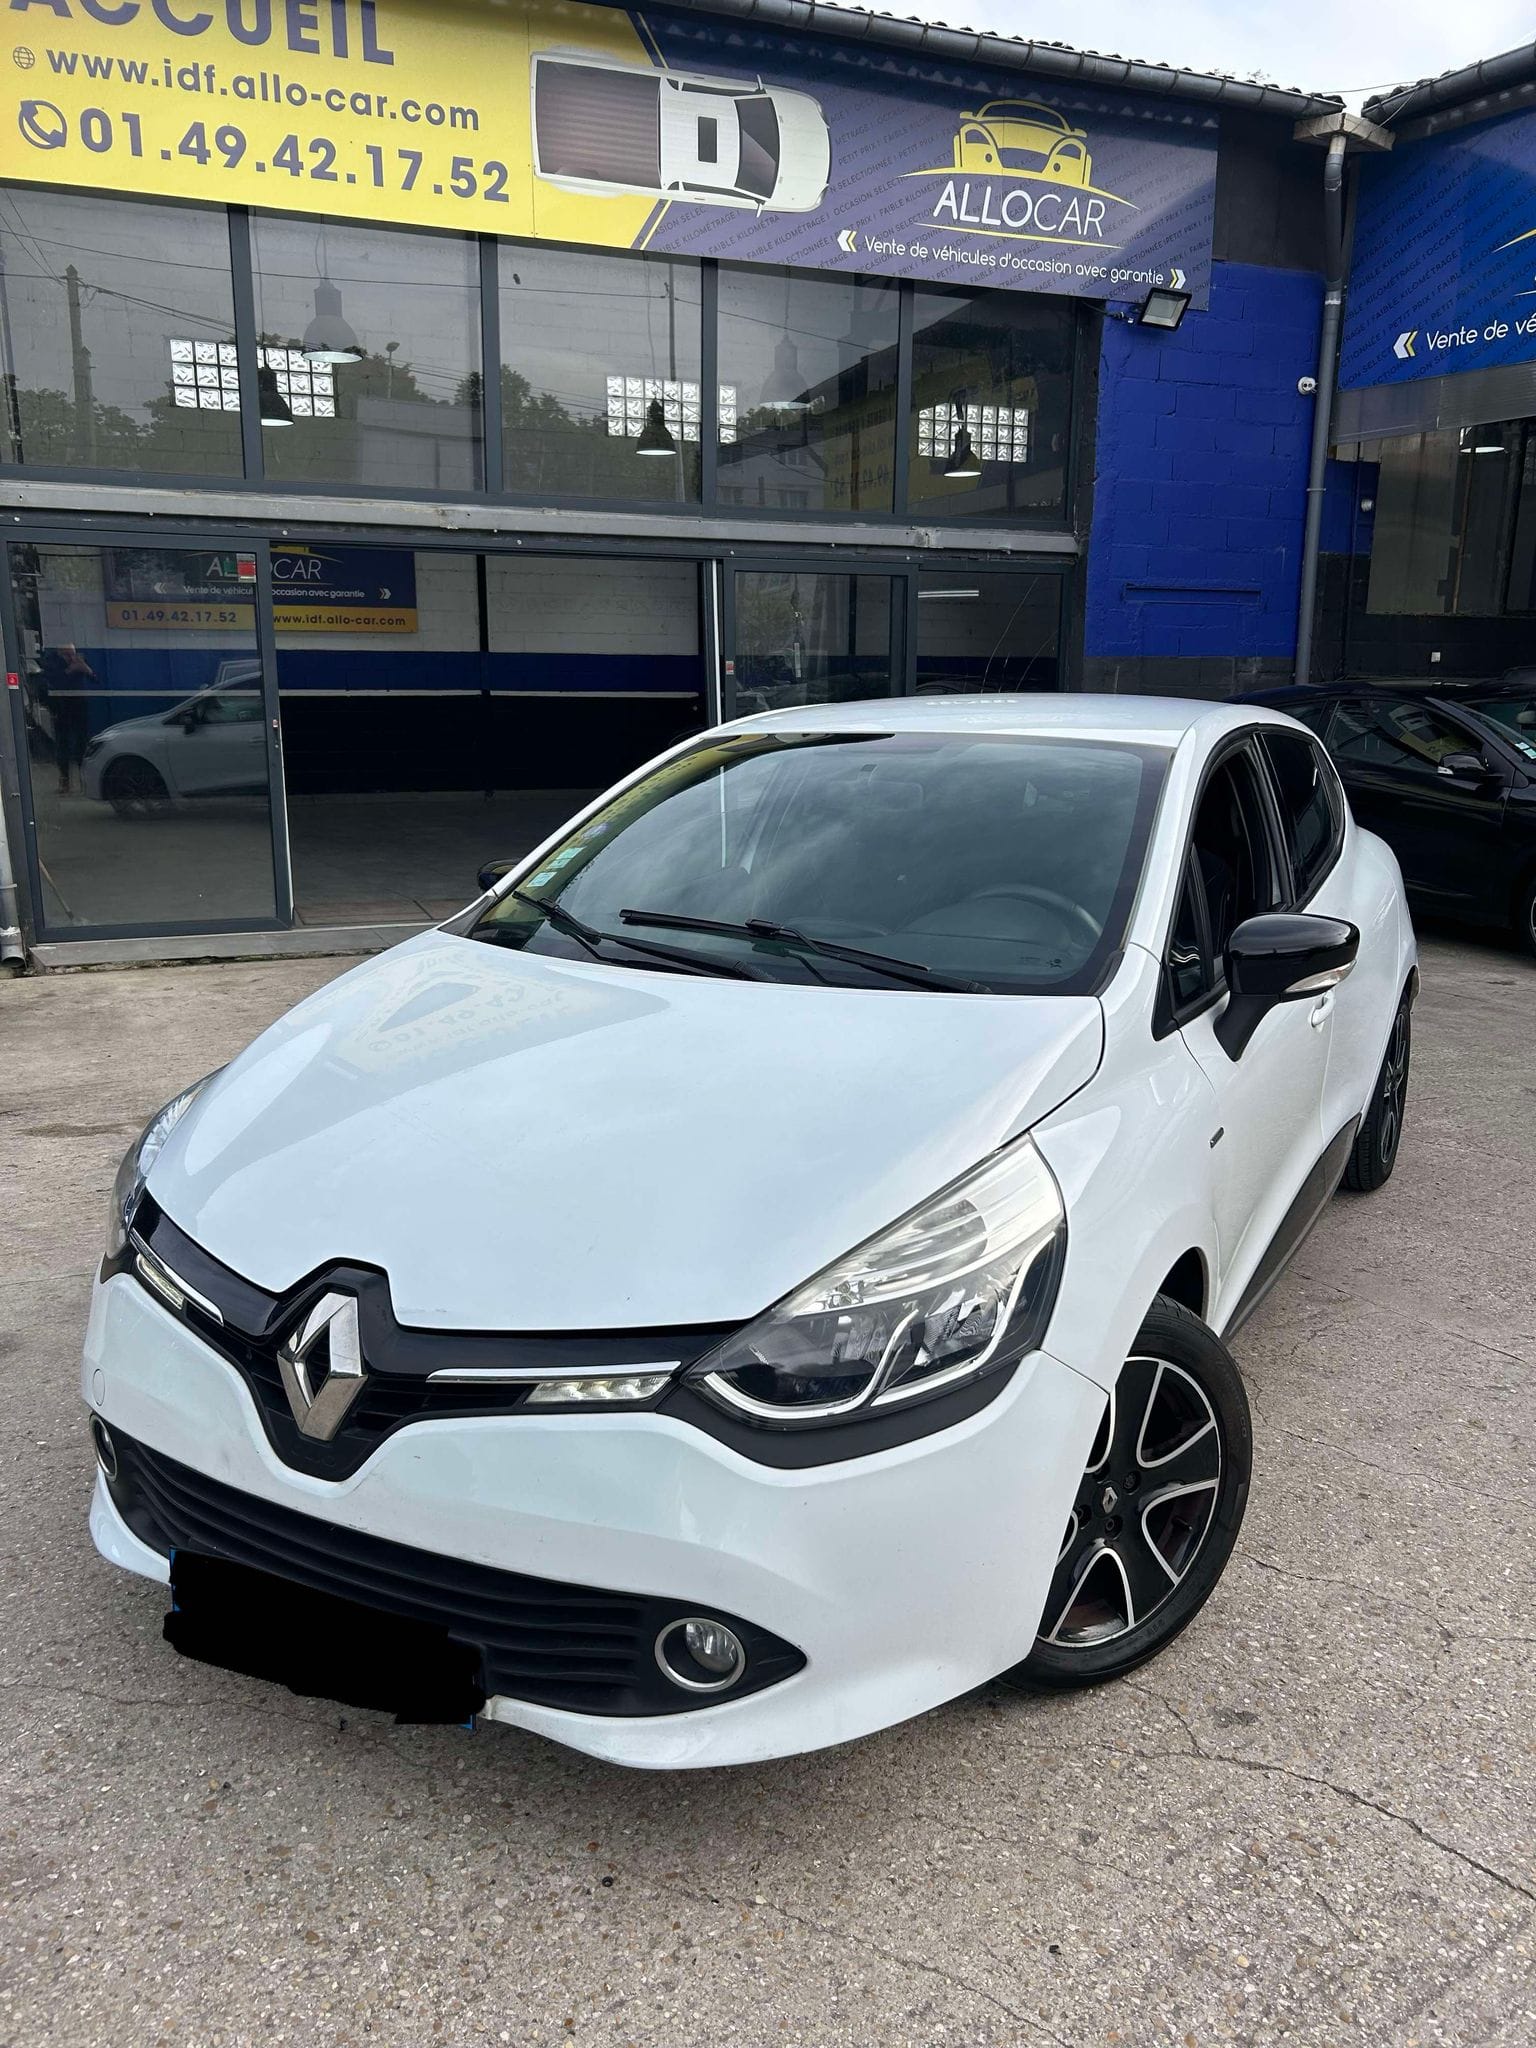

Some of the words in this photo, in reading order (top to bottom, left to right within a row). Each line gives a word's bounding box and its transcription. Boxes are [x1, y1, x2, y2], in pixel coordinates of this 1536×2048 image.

[10, 0, 394, 65] CUEIL
[46, 48, 480, 131] www.idf.allo-car.com
[80, 108, 510, 203] 01.49.42.17.52
[746, 241, 773, 260] FAIBLE
[833, 191, 872, 216] OCCASION
[933, 180, 1105, 237] ALLOCAR
[865, 235, 906, 256] Vente
[910, 242, 929, 258] de
[932, 245, 996, 267] véhicules
[1000, 252, 1072, 275] d'occasion
[1075, 264, 1107, 278] avec
[1111, 268, 1164, 285] garantie
[1426, 326, 1478, 351] Vente
[1484, 320, 1509, 341] de
[121, 609, 237, 623] 01.49.42.17.52
[183, 586, 209, 595] Vente
[211, 586, 222, 595] de
[272, 588, 308, 597] occasion
[309, 590, 329, 598] avec
[330, 590, 366, 599] garantie
